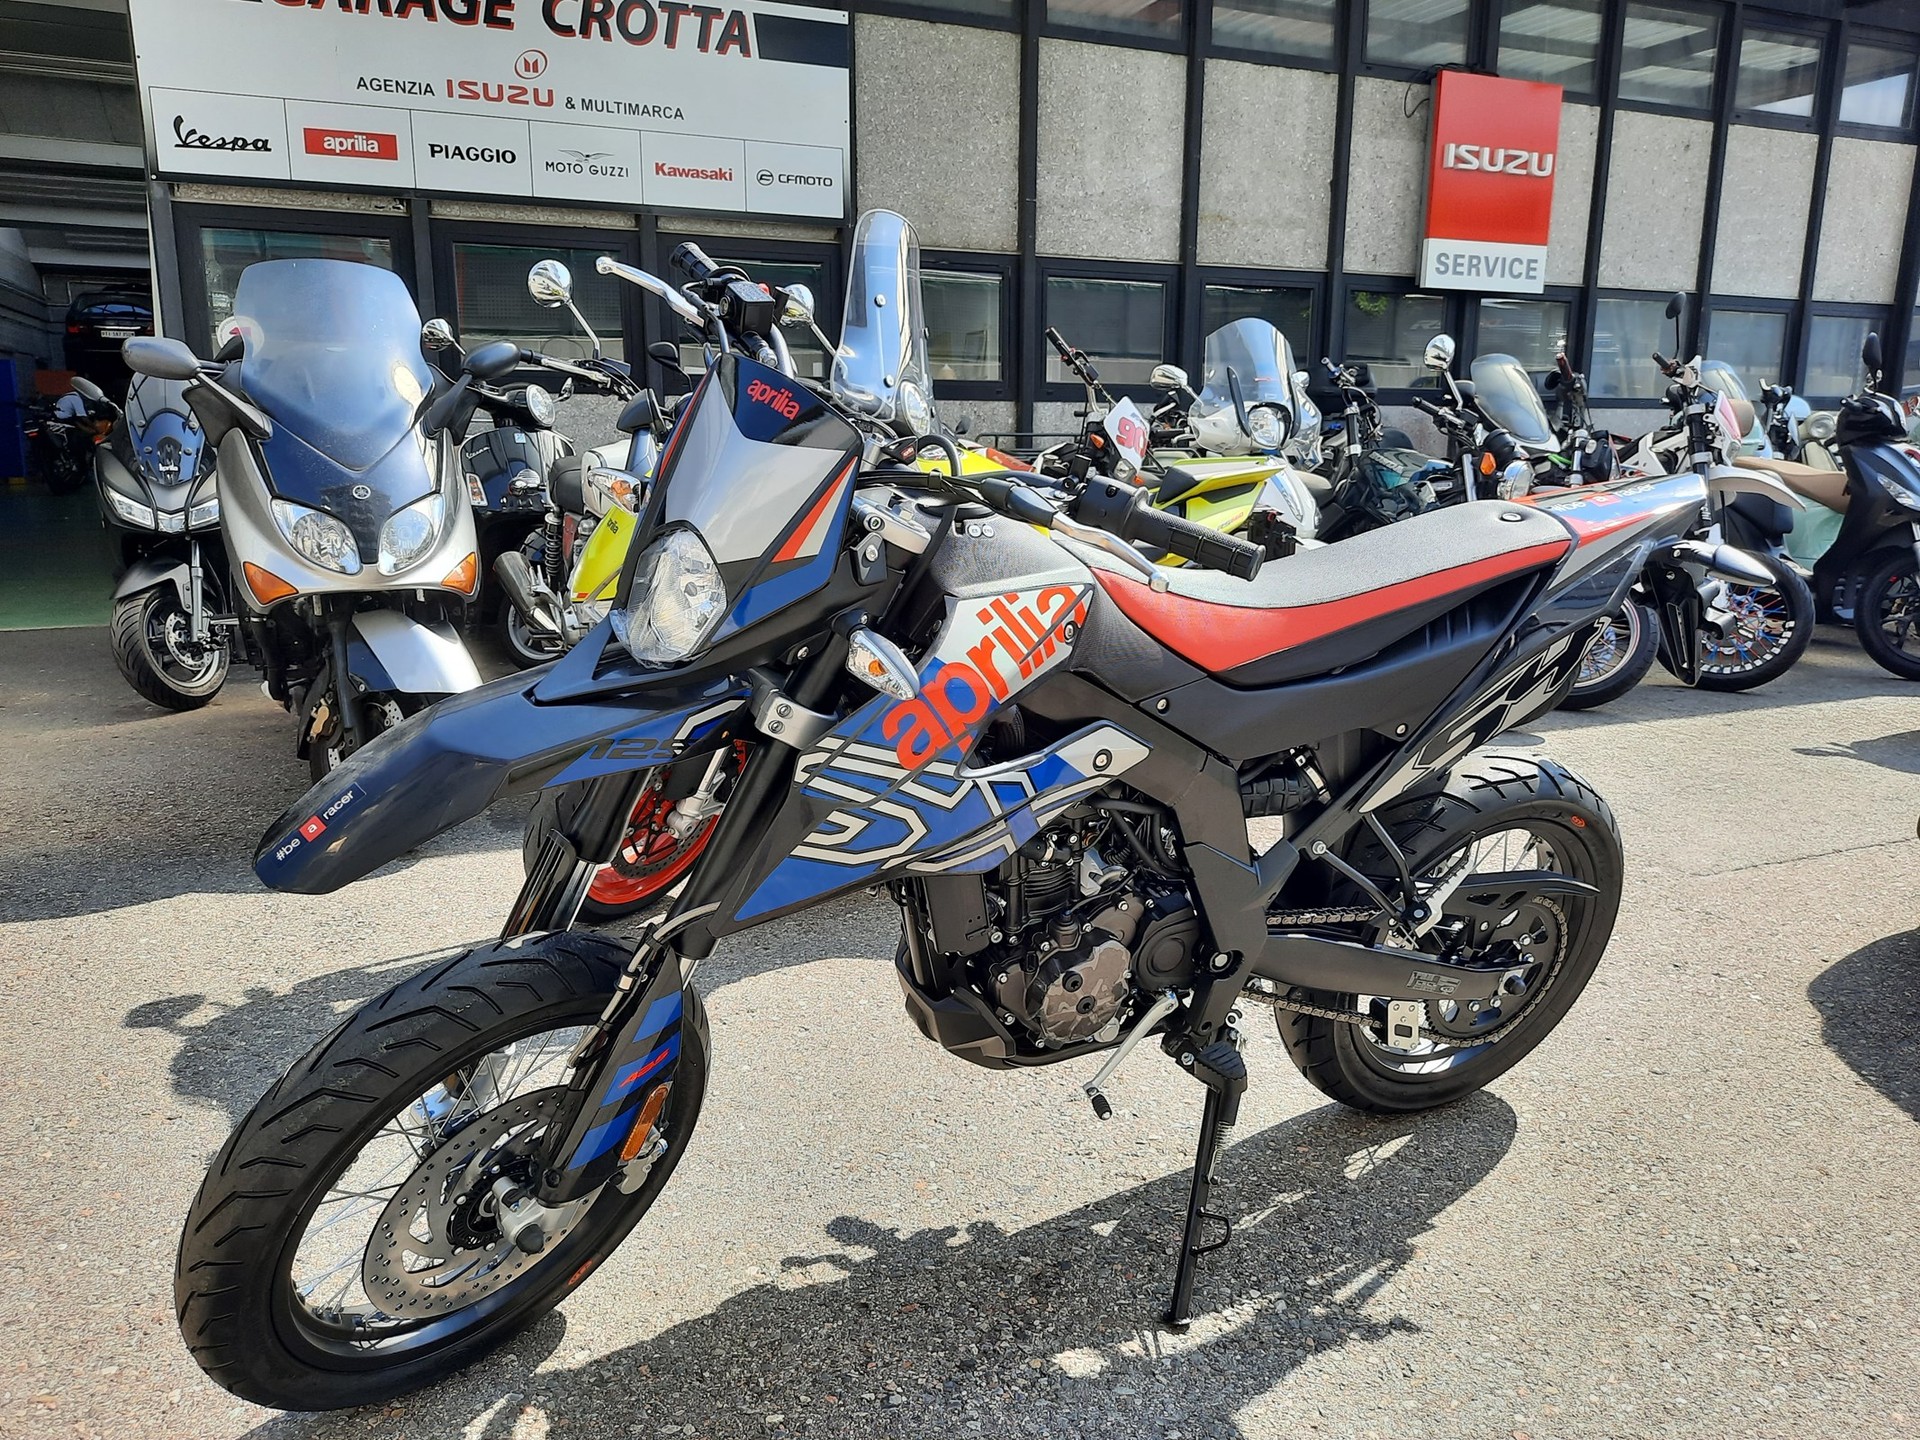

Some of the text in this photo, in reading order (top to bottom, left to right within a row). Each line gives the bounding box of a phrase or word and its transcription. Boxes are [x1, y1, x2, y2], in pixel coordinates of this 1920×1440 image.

[541, 0, 751, 58] CROTTA
[356, 76, 685, 121] AGENZIA ISUZU & MULTIMARCA
[173, 115, 272, 151] Vespa
[322, 134, 380, 154] aprilia
[428, 143, 517, 165] PIAGGIO
[545, 160, 629, 178] MOTO GUZZI
[654, 161, 733, 182] Kawasaki
[1443, 143, 1554, 178] ISUZU
[778, 173, 833, 188] CFMOTO
[1435, 252, 1539, 281] SERVICE
[746, 378, 801, 421] aprilia
[881, 585, 1087, 771] aprilia
[275, 790, 354, 861] #be a racer
